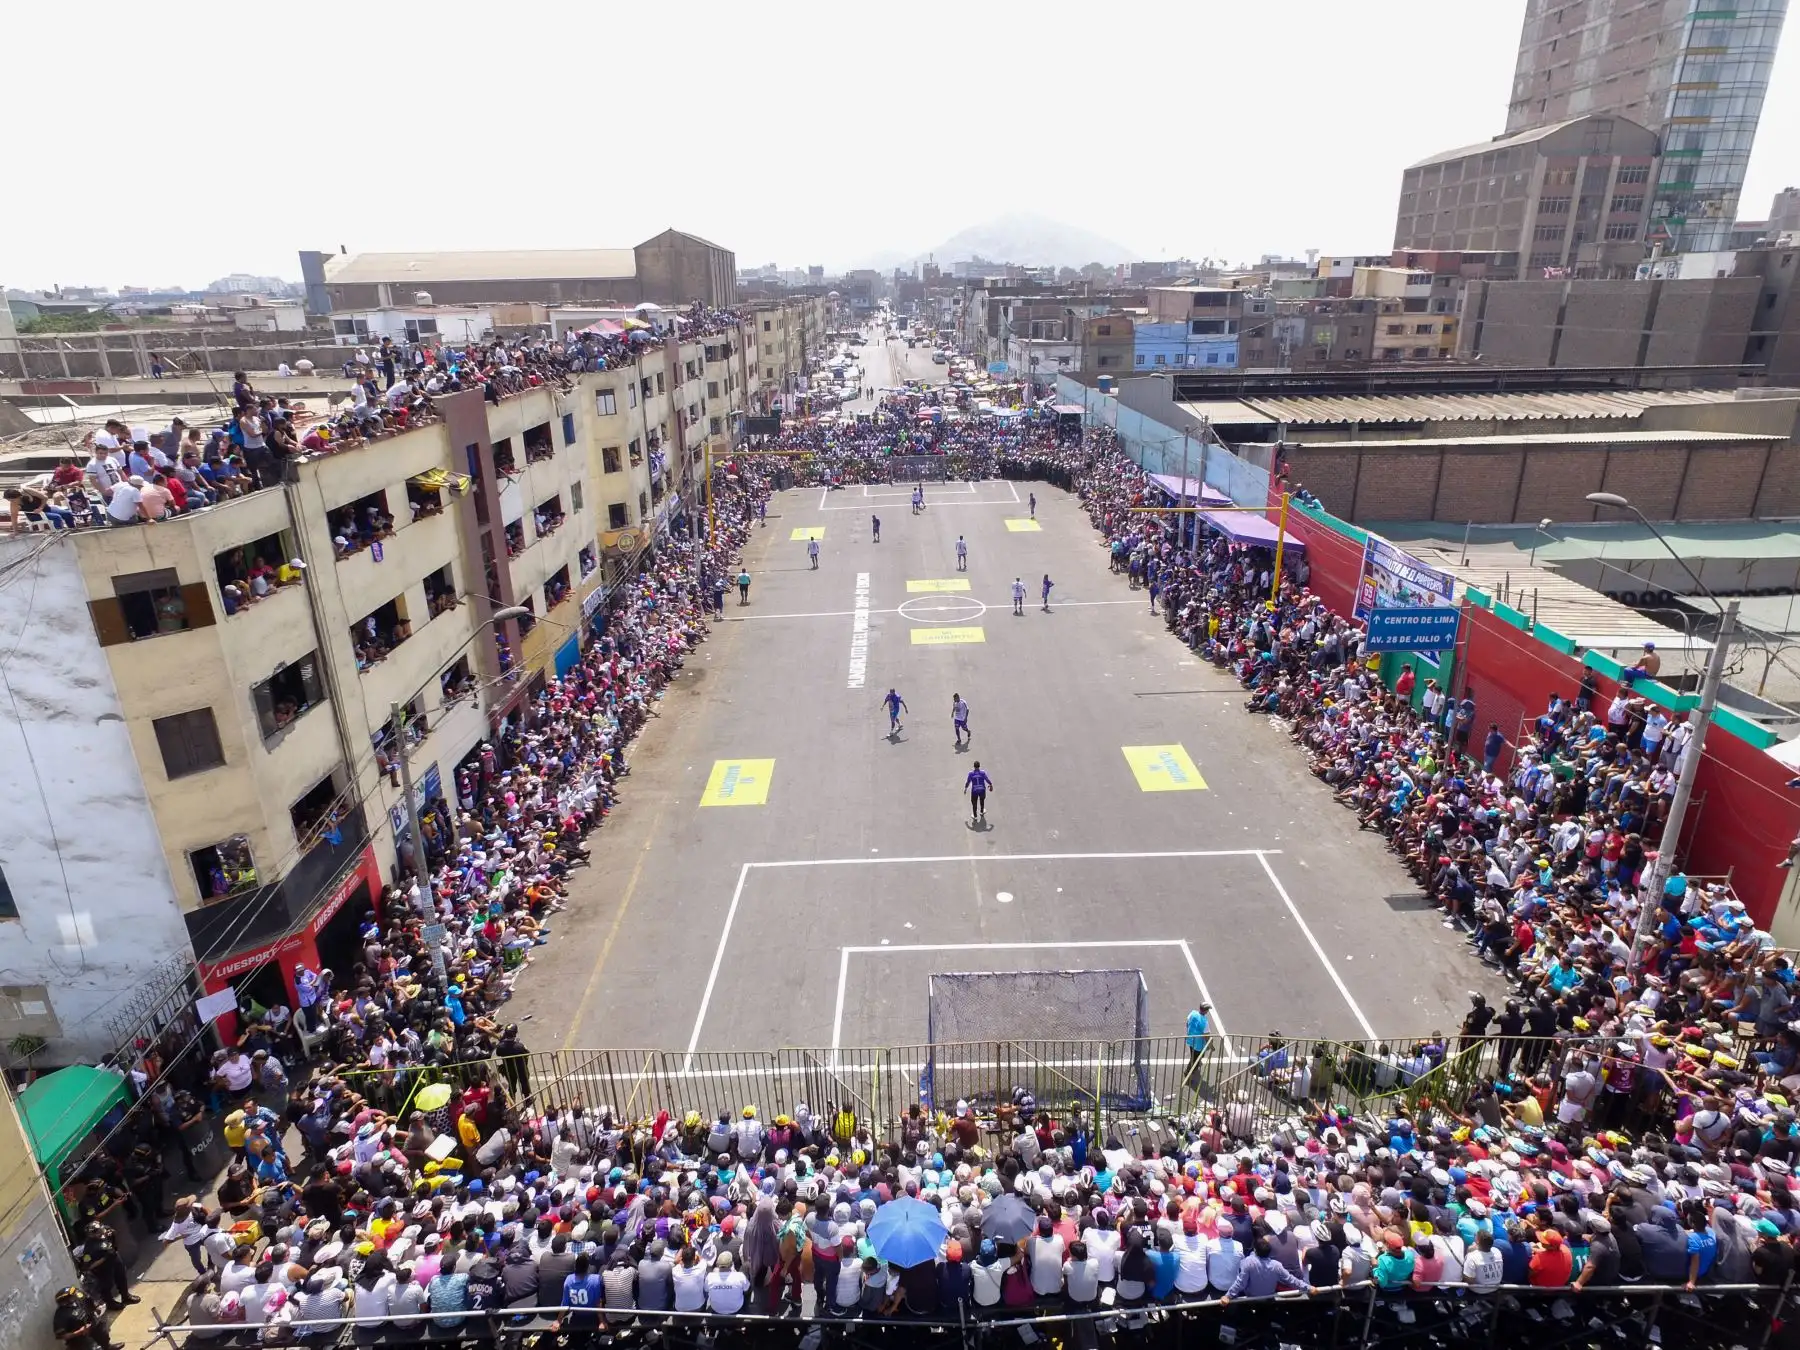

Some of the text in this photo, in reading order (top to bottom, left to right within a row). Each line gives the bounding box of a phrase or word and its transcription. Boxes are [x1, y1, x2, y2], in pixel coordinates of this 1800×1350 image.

[1384, 616, 1455, 624] CENTRO DE LIMA
[1370, 636, 1384, 644] AV.
[1413, 635, 1440, 643] JULIO
[313, 886, 347, 933] LIVESPORT
[216, 947, 278, 978] LIVESPORT
[1621, 1069, 1631, 1081] 3
[472, 1294, 483, 1310] 2
[569, 1288, 589, 1305] 50
